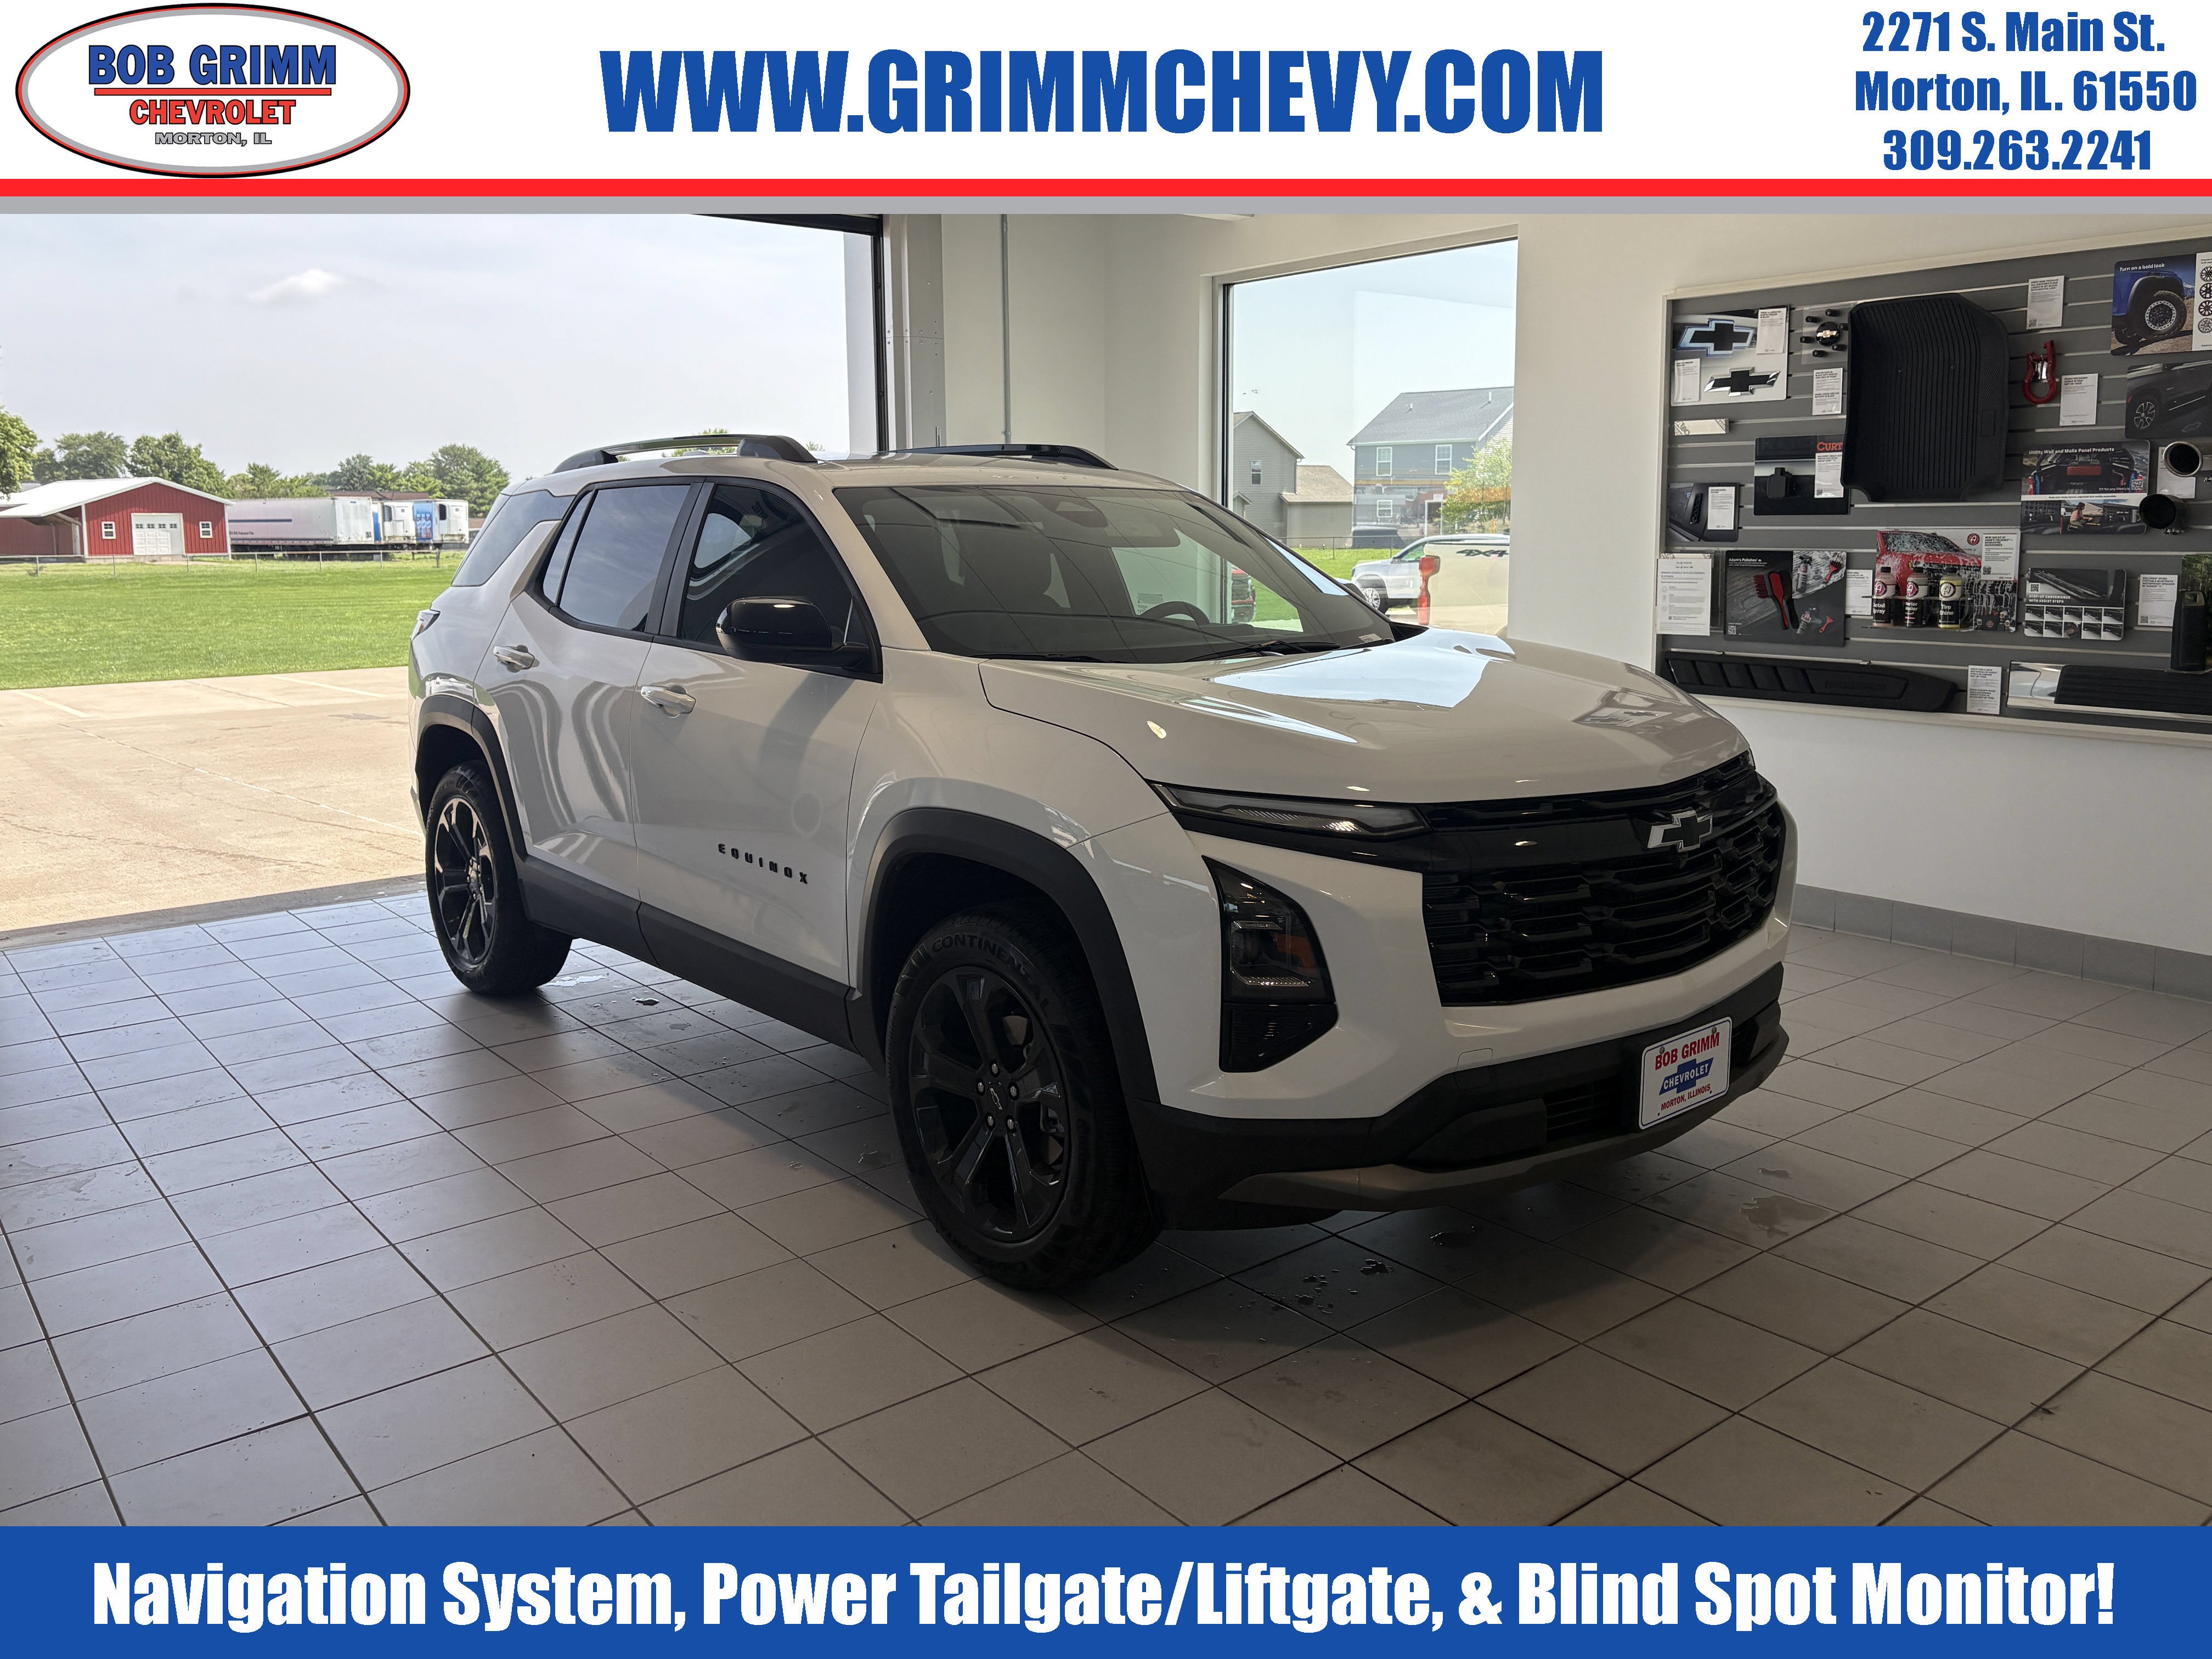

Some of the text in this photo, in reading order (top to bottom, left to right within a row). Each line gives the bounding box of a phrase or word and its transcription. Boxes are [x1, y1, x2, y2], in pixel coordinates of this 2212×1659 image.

[1817, 442, 1843, 451] CURT
[718, 843, 808, 884] EQUINOX
[1655, 1032, 1720, 1070] BOB GRIMM
[1663, 1063, 1709, 1090] CHEVROLET
[1661, 1084, 1711, 1111] MORTON, ILLINOIS
